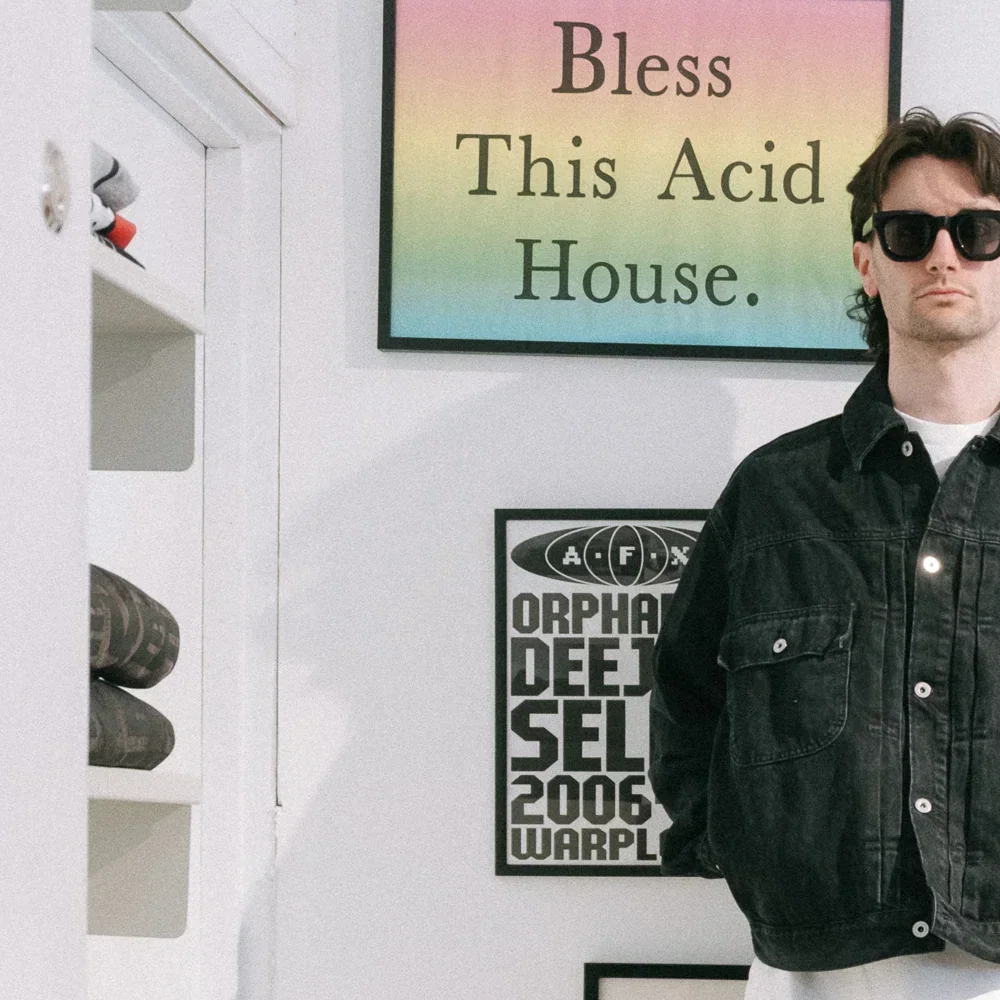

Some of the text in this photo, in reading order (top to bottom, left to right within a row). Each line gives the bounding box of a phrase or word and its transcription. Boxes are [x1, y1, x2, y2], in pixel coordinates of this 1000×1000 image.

[552, 21, 732, 98] Bless
[456, 133, 825, 205] This Acid
[514, 238, 759, 307] House.
[511, 775, 662, 825] 2006
[511, 828, 668, 861] WARPL
